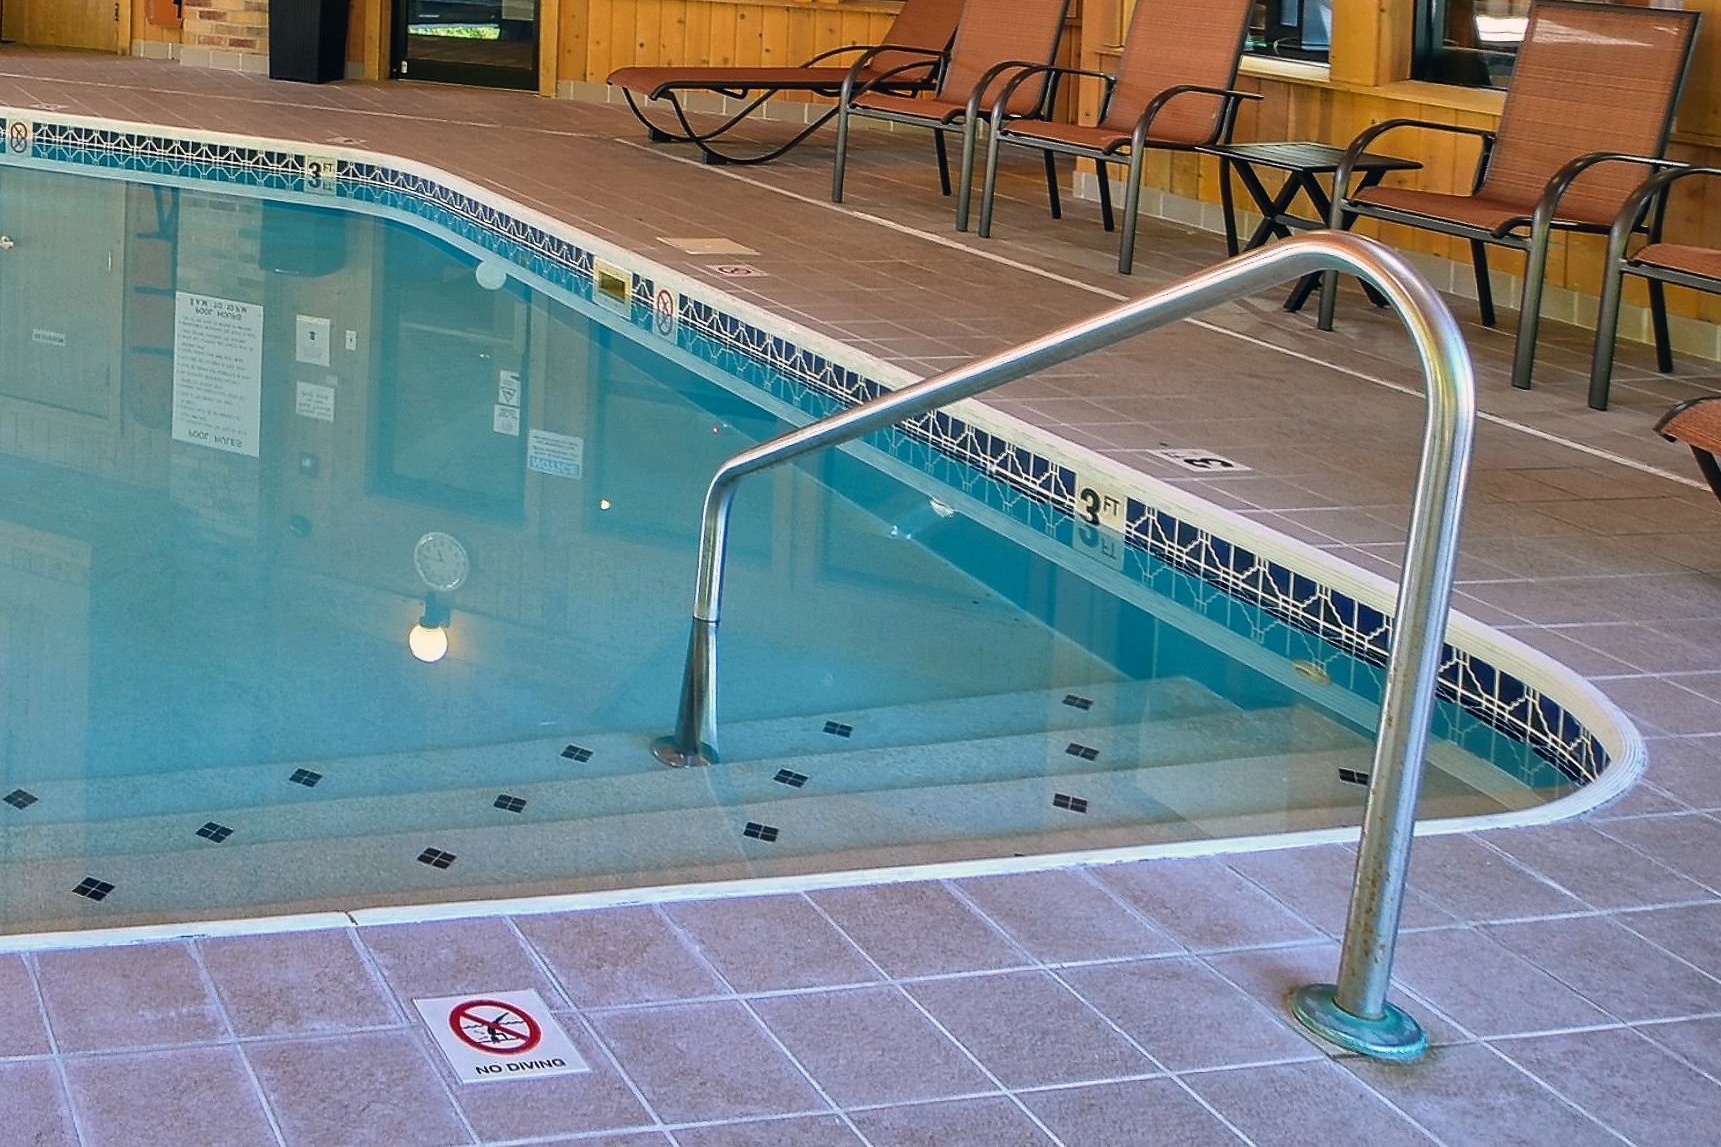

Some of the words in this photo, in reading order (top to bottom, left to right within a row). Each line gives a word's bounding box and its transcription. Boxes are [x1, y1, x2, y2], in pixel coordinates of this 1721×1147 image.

[309, 162, 322, 178] 3
[323, 163, 334, 171] FT
[1080, 487, 1101, 525] 3
[1104, 495, 1120, 517] FT
[476, 1064, 502, 1075] NO
[506, 1058, 566, 1071] DIVING
